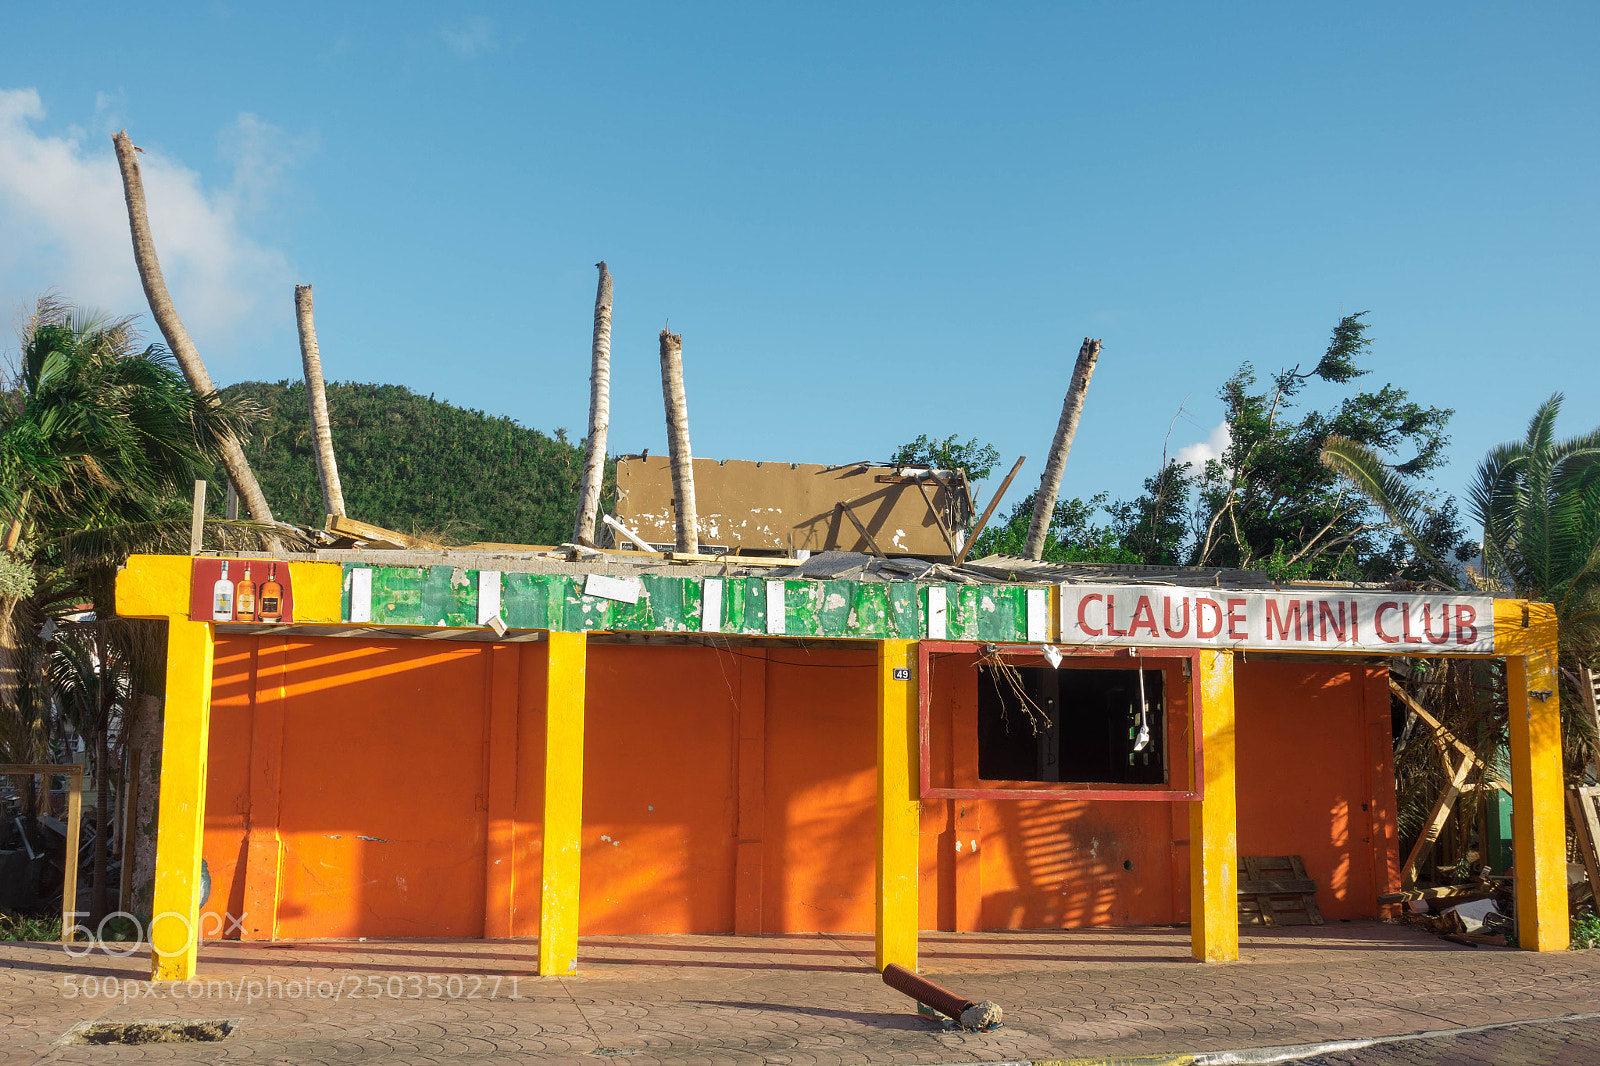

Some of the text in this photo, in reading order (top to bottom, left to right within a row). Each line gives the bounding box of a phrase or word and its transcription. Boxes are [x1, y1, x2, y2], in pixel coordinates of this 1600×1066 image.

[1077, 593, 1478, 645] CLAUDE MINI CLUB
[897, 670, 909, 678] 49
[1045, 696, 1056, 766] DVID
